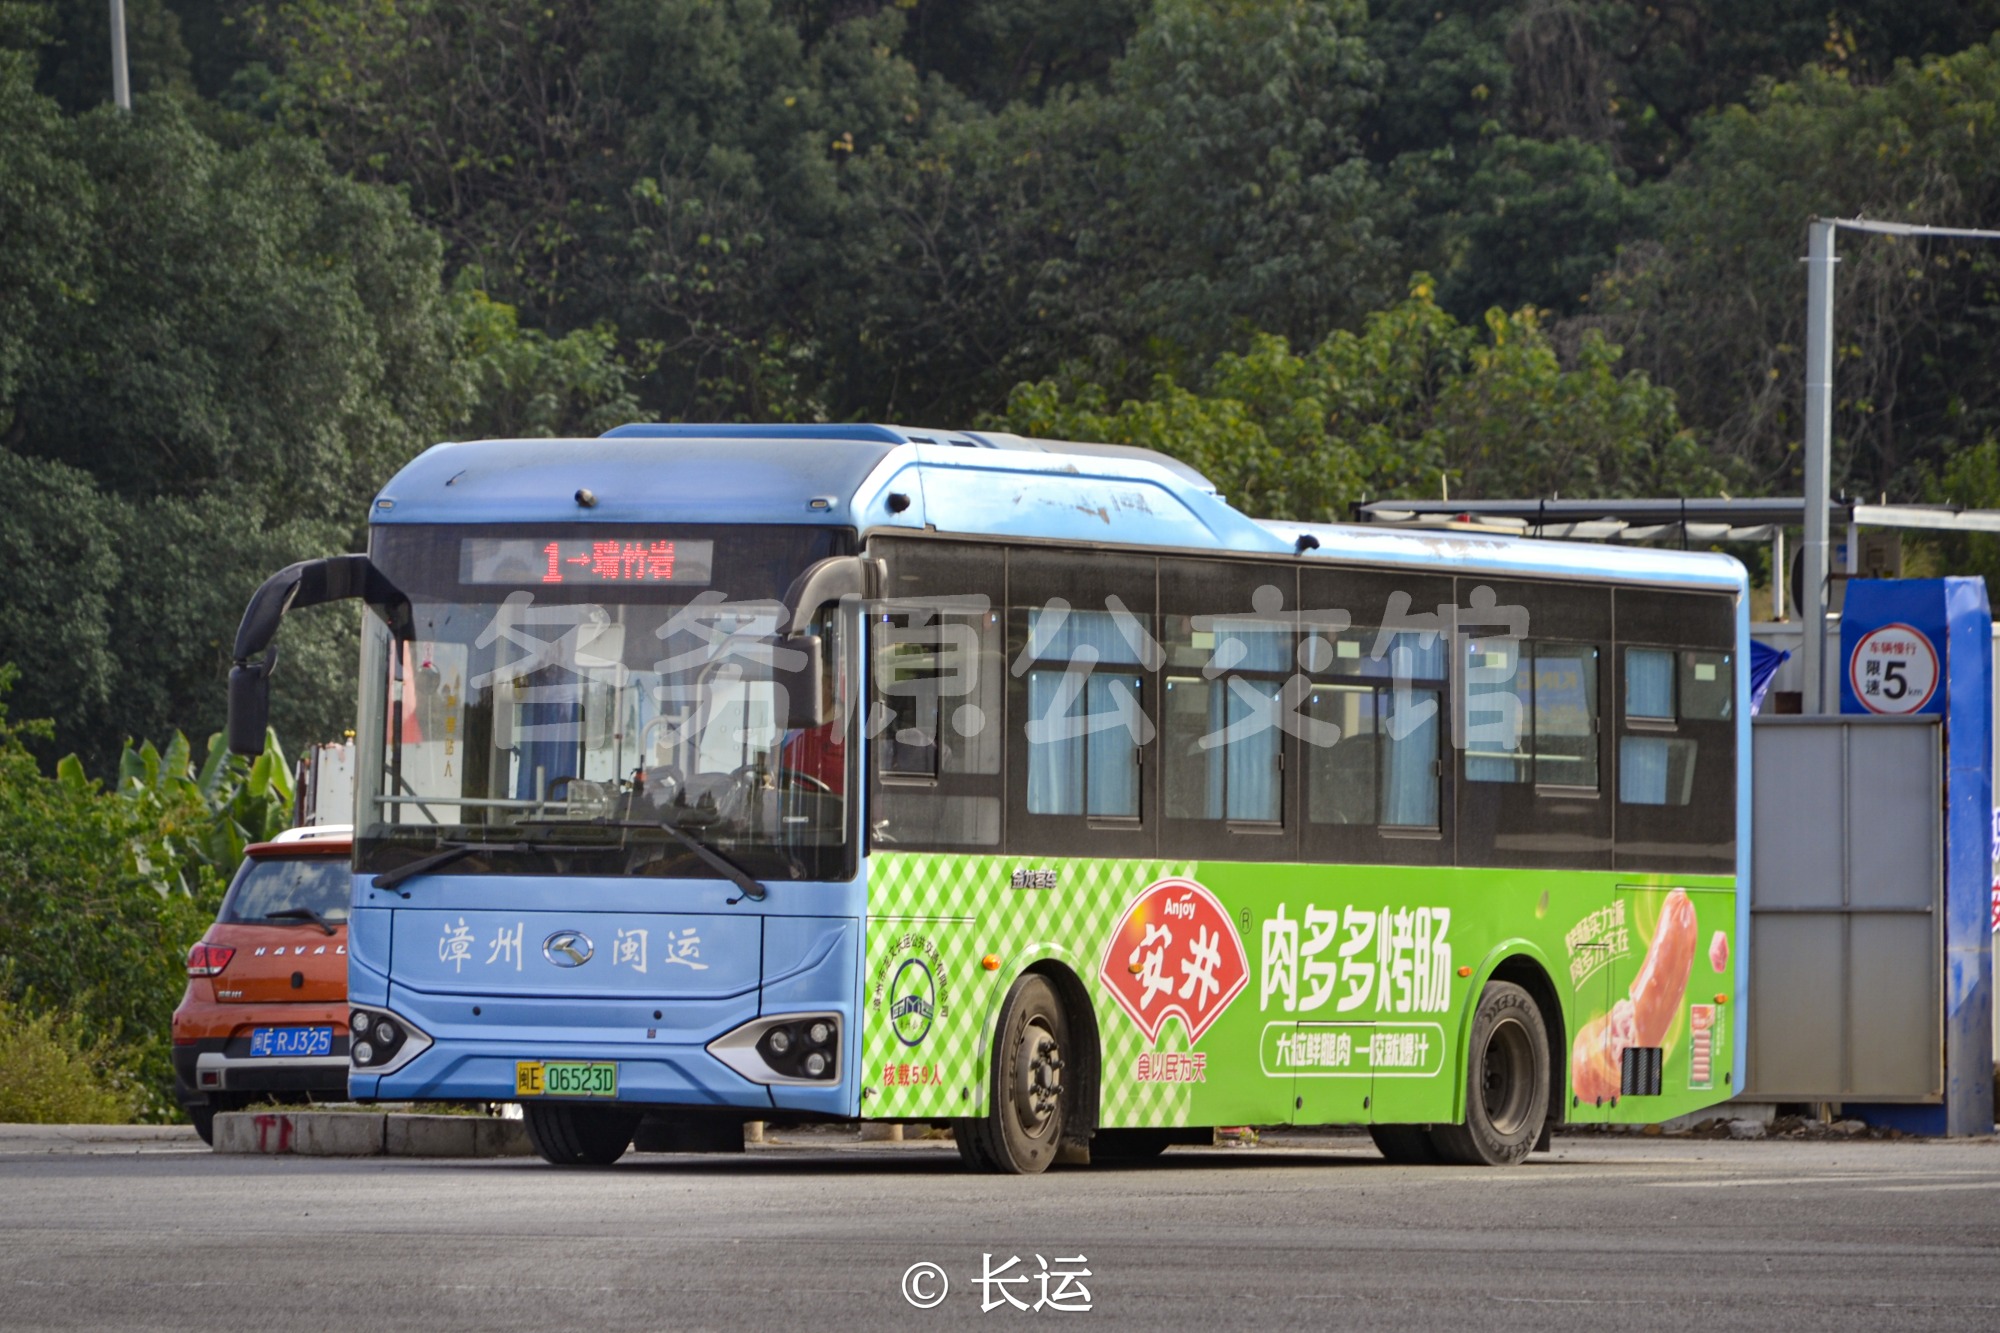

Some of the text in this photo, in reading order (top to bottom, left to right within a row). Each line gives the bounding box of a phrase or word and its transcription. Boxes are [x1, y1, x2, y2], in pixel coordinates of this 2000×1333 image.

[542, 540, 675, 582] 1 瑞竹岩
[1870, 641, 1917, 655] 车辆慢行
[1865, 660, 1881, 696] 限速
[1011, 870, 1057, 889] 金龙客车
[1164, 897, 1196, 919] Anjoy
[255, 945, 346, 956] HAVAL
[438, 916, 709, 974] 漳州 闽运
[1260, 902, 1452, 1013] 肉多多烤肠
[1129, 924, 1221, 1012] 安井
[1276, 1032, 1429, 1067] 大粒鲜腿肉 一咬就爆汁
[883, 1063, 942, 1087] 核载59人
[1137, 1053, 1206, 1082] 食以民为天
